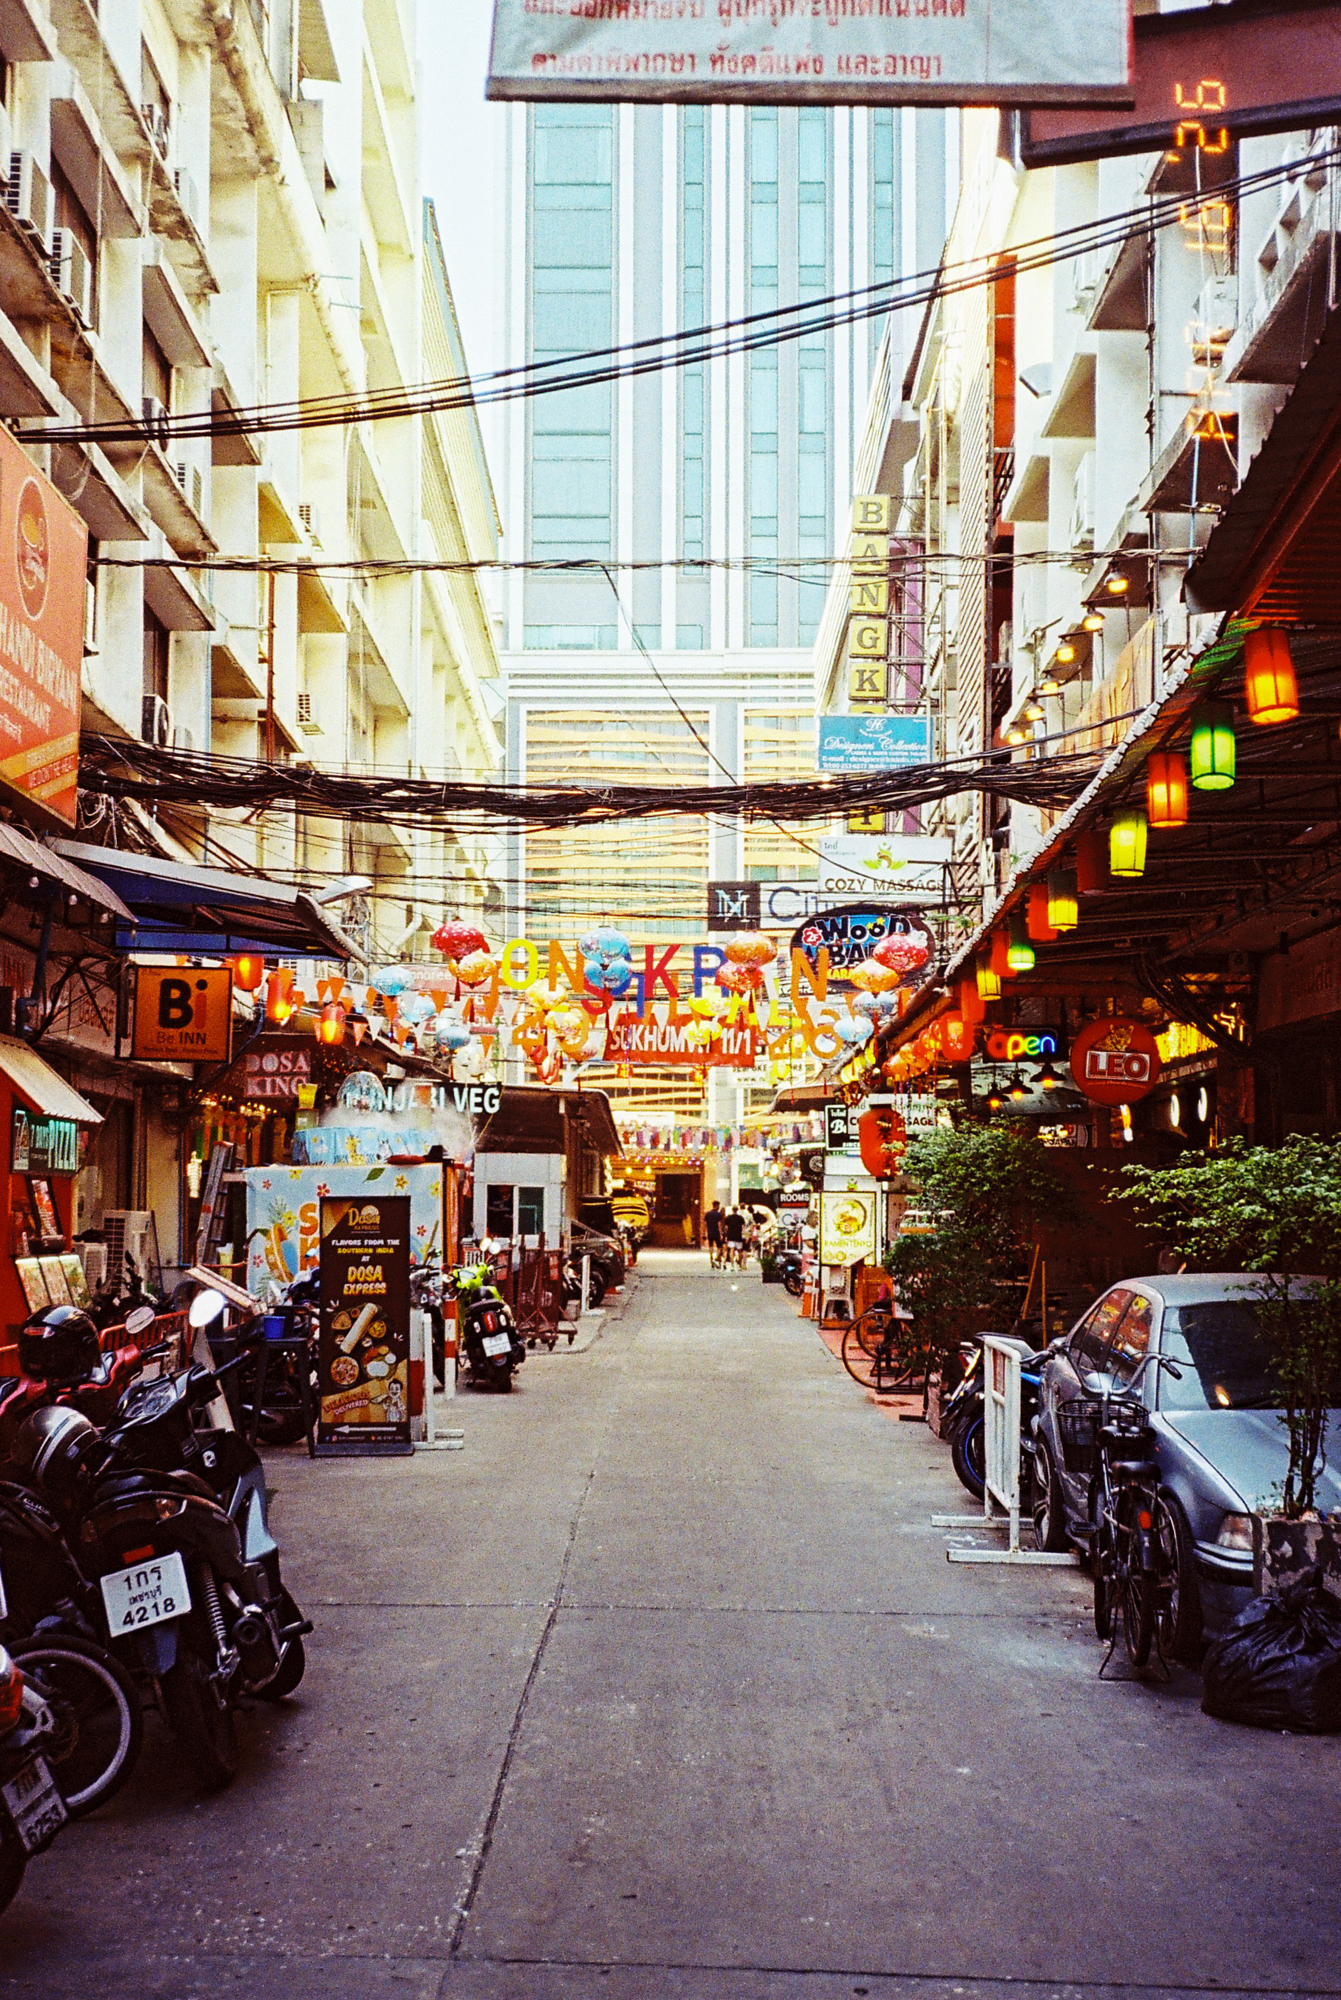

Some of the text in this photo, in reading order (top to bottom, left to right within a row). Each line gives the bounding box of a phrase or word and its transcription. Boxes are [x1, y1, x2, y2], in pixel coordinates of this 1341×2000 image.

[857, 501, 884, 716] BANGK
[823, 736, 875, 755] Designers
[824, 878, 867, 892] COZY
[158, 978, 208, 1030] Bi
[179, 1034, 207, 1045] INN
[609, 1022, 751, 1055] SUKHUM 11/1
[245, 1051, 311, 1073] DOSA
[1088, 1052, 1149, 1080] LEO
[245, 1075, 307, 1097] KING
[453, 1087, 500, 1114] VEG
[780, 1193, 809, 1202] ROOMS
[347, 1264, 383, 1283] DOSA
[342, 1282, 387, 1296] EXPRESS
[123, 1565, 162, 1592] 1กร
[122, 1597, 176, 1626] 4218
